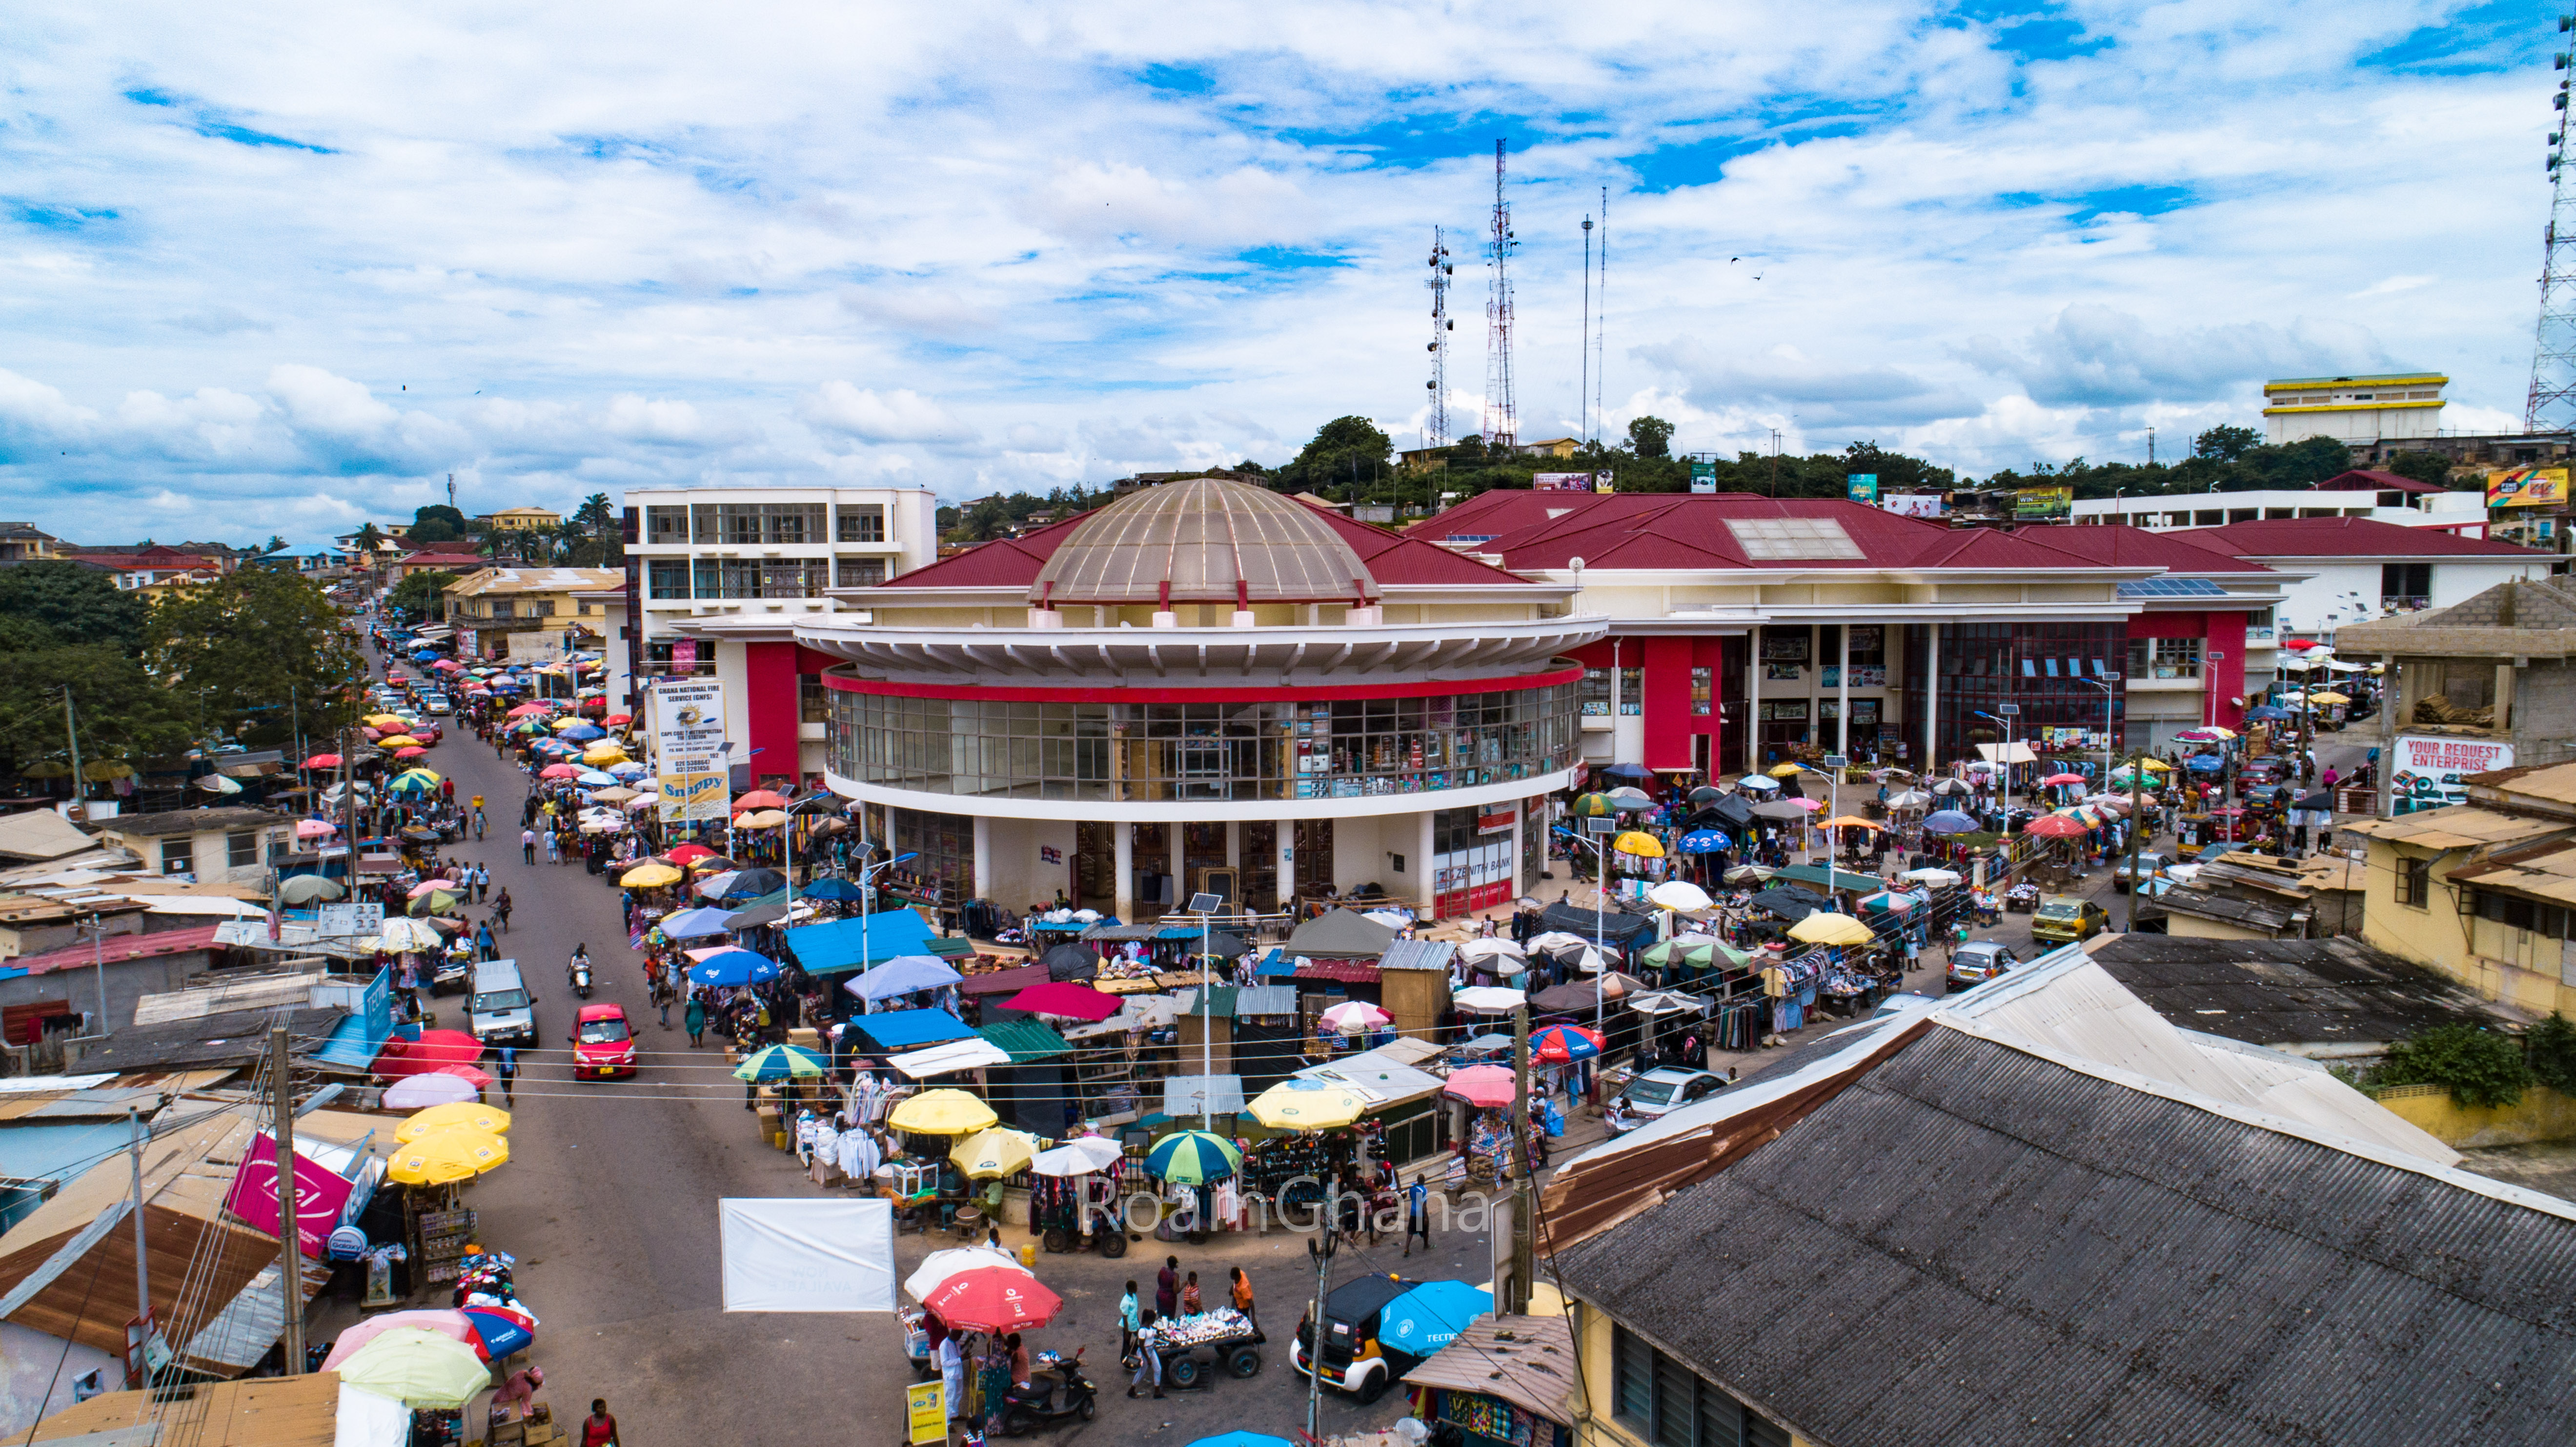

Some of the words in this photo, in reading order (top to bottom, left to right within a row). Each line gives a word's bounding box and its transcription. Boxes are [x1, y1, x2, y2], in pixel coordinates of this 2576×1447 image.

[2407, 740, 2440, 754] YOUR
[2445, 743, 2501, 759] REQUEST
[2412, 754, 2489, 772] ENTERPRISE
[665, 777, 723, 797] Snappy
[1456, 863, 1488, 879] ZENITH
[1491, 856, 1511, 871] BANK
[706, 969, 720, 978] tigo
[367, 979, 387, 1016] TECNO
[332, 1242, 362, 1252] Galaxy
